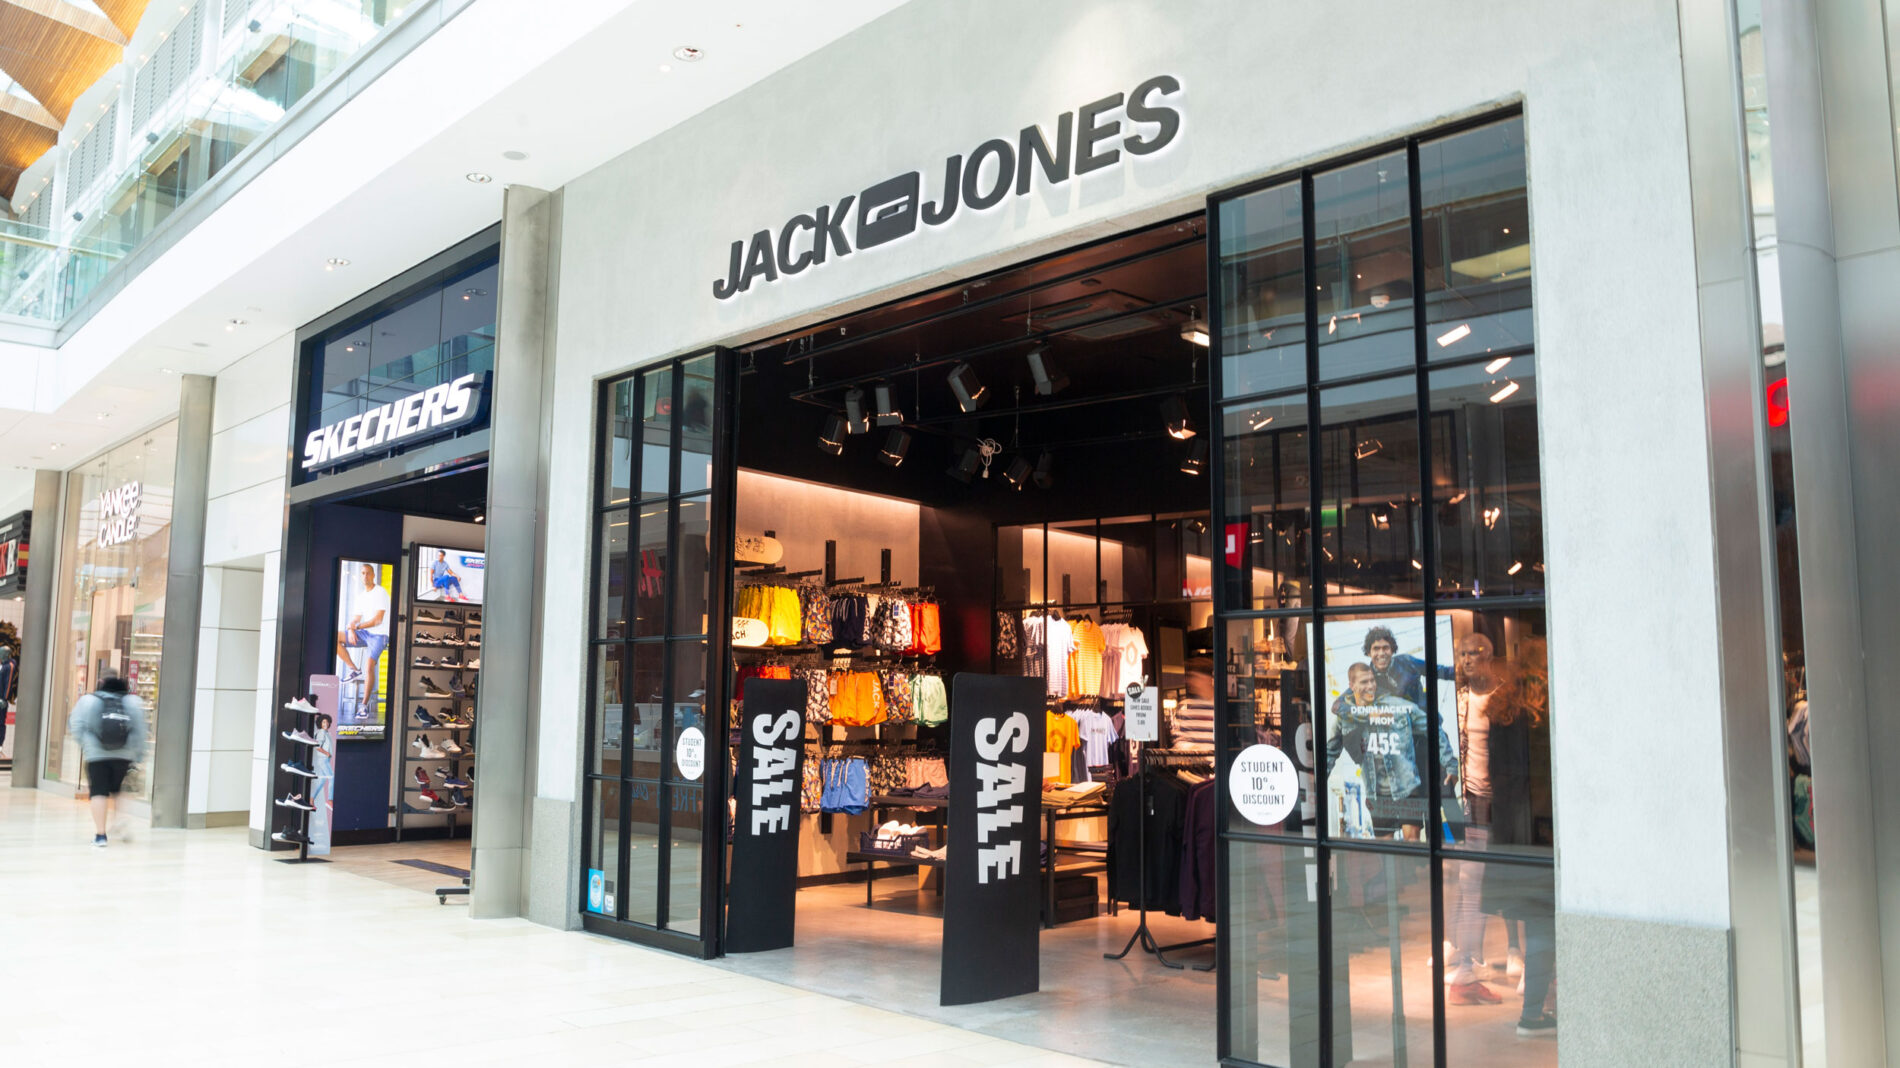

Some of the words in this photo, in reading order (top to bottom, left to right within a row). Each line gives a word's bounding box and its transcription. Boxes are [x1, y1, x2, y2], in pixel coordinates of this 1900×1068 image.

[713, 195, 856, 300] JACK
[921, 75, 1181, 226] JONES
[302, 373, 477, 469] SKECHERS
[1350, 705, 1378, 715] DENIM
[1379, 704, 1413, 714] JACKET
[1369, 717, 1395, 726] FROM
[682, 737, 702, 746] STUDENT
[1367, 732, 1401, 756] 45£
[681, 759, 702, 767] DISCOUNT
[1241, 761, 1284, 773] STUDENT
[751, 709, 801, 836] SALE
[974, 711, 1030, 884] SALE
[1242, 793, 1285, 805] DISCOUNT
